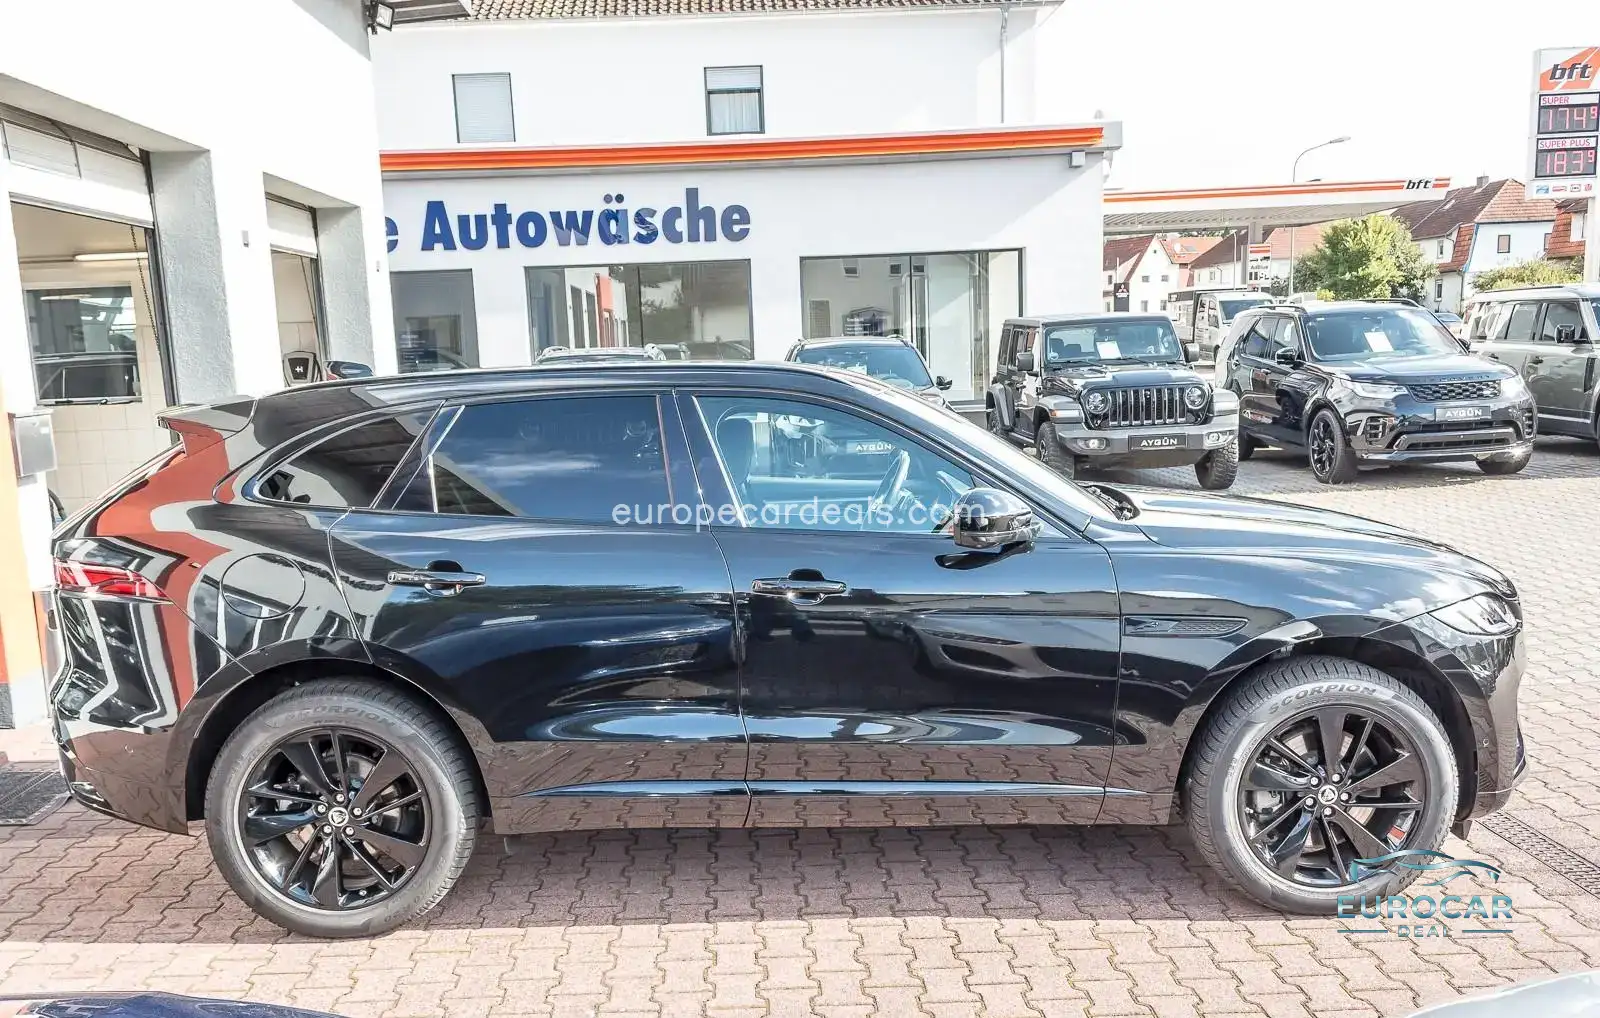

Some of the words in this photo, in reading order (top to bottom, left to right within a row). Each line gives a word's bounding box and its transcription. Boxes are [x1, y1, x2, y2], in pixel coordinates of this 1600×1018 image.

[1549, 63, 1592, 81] bft
[1542, 96, 1570, 105] SUPER
[1539, 139, 1567, 149] SUPER
[1570, 138, 1591, 147] PLUS
[1406, 179, 1432, 190] bft
[420, 187, 752, 252] Autowäsche
[1445, 407, 1483, 418] AYGÜN
[1140, 436, 1178, 447] AYGÜN
[1267, 684, 1377, 715] SCORPION
[286, 704, 395, 727] ORPION
